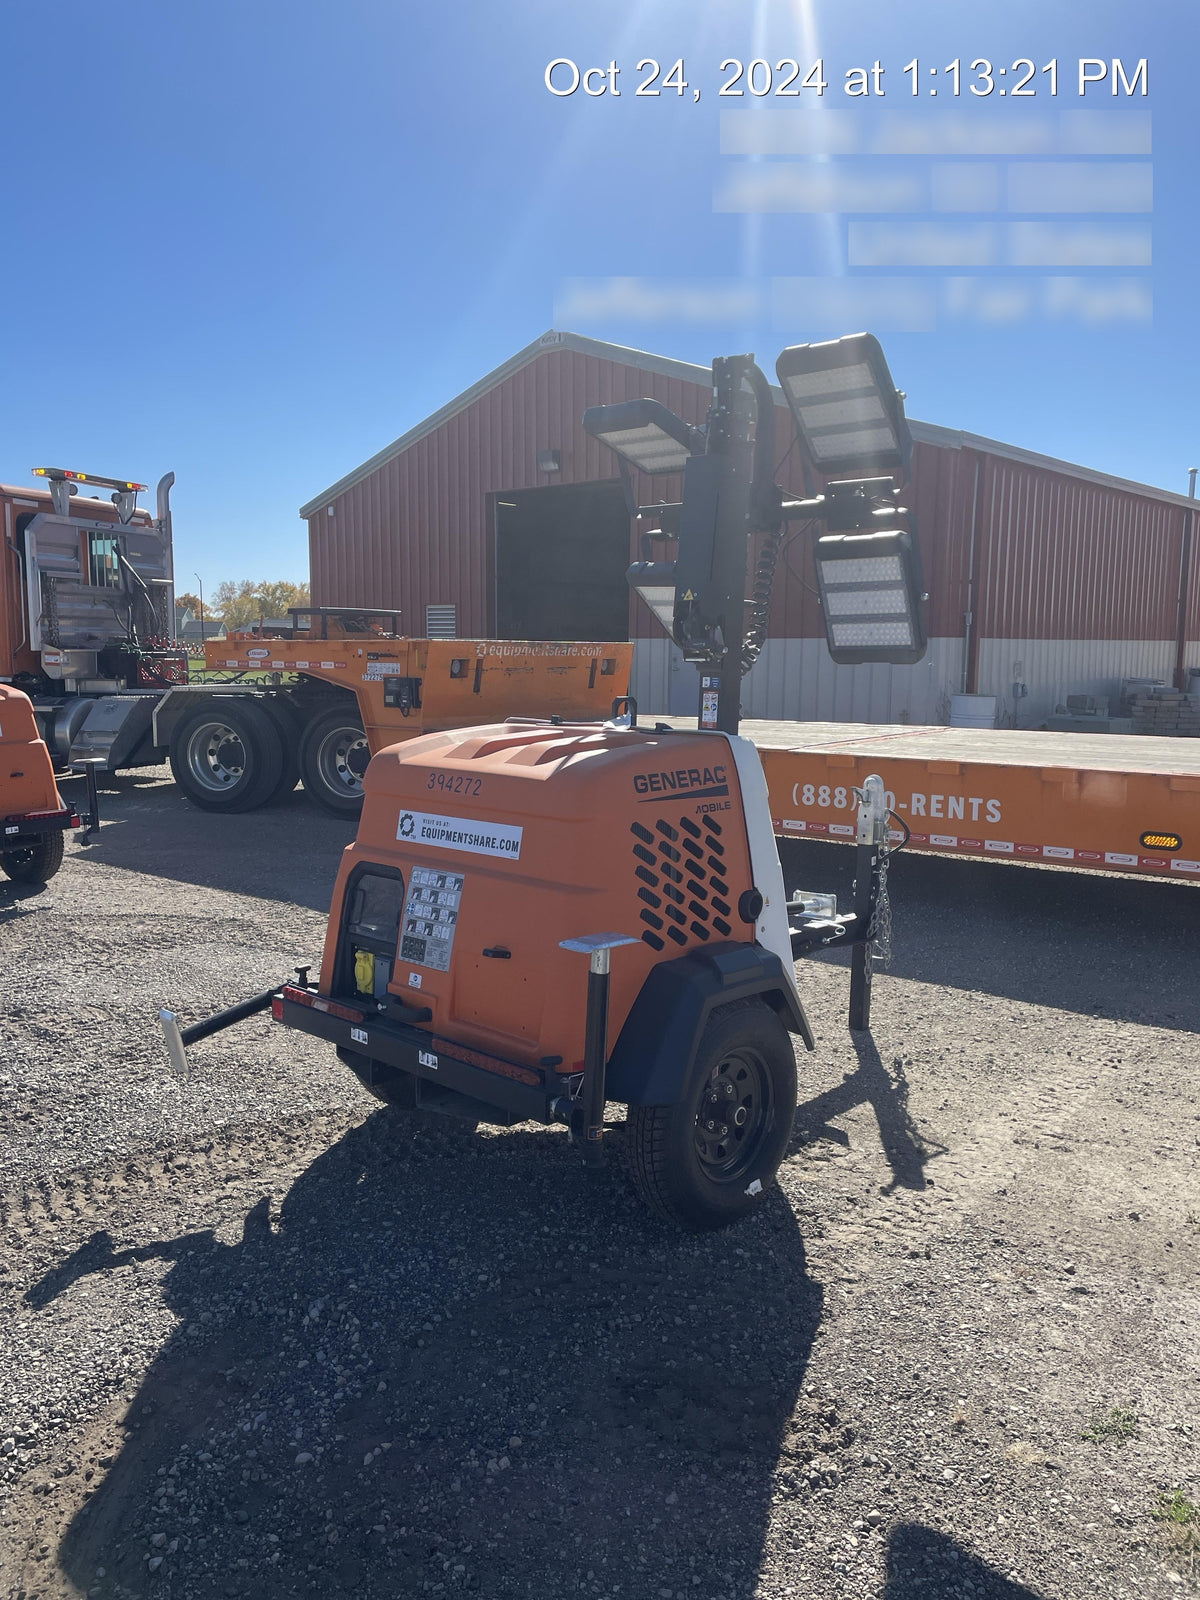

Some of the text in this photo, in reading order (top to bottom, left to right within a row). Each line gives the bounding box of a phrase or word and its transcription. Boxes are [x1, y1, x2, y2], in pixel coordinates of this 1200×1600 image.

[427, 772, 482, 796] 394272
[633, 765, 727, 793] GENERAC
[421, 827, 519, 852] EQUIPMENTSHARE.COM
